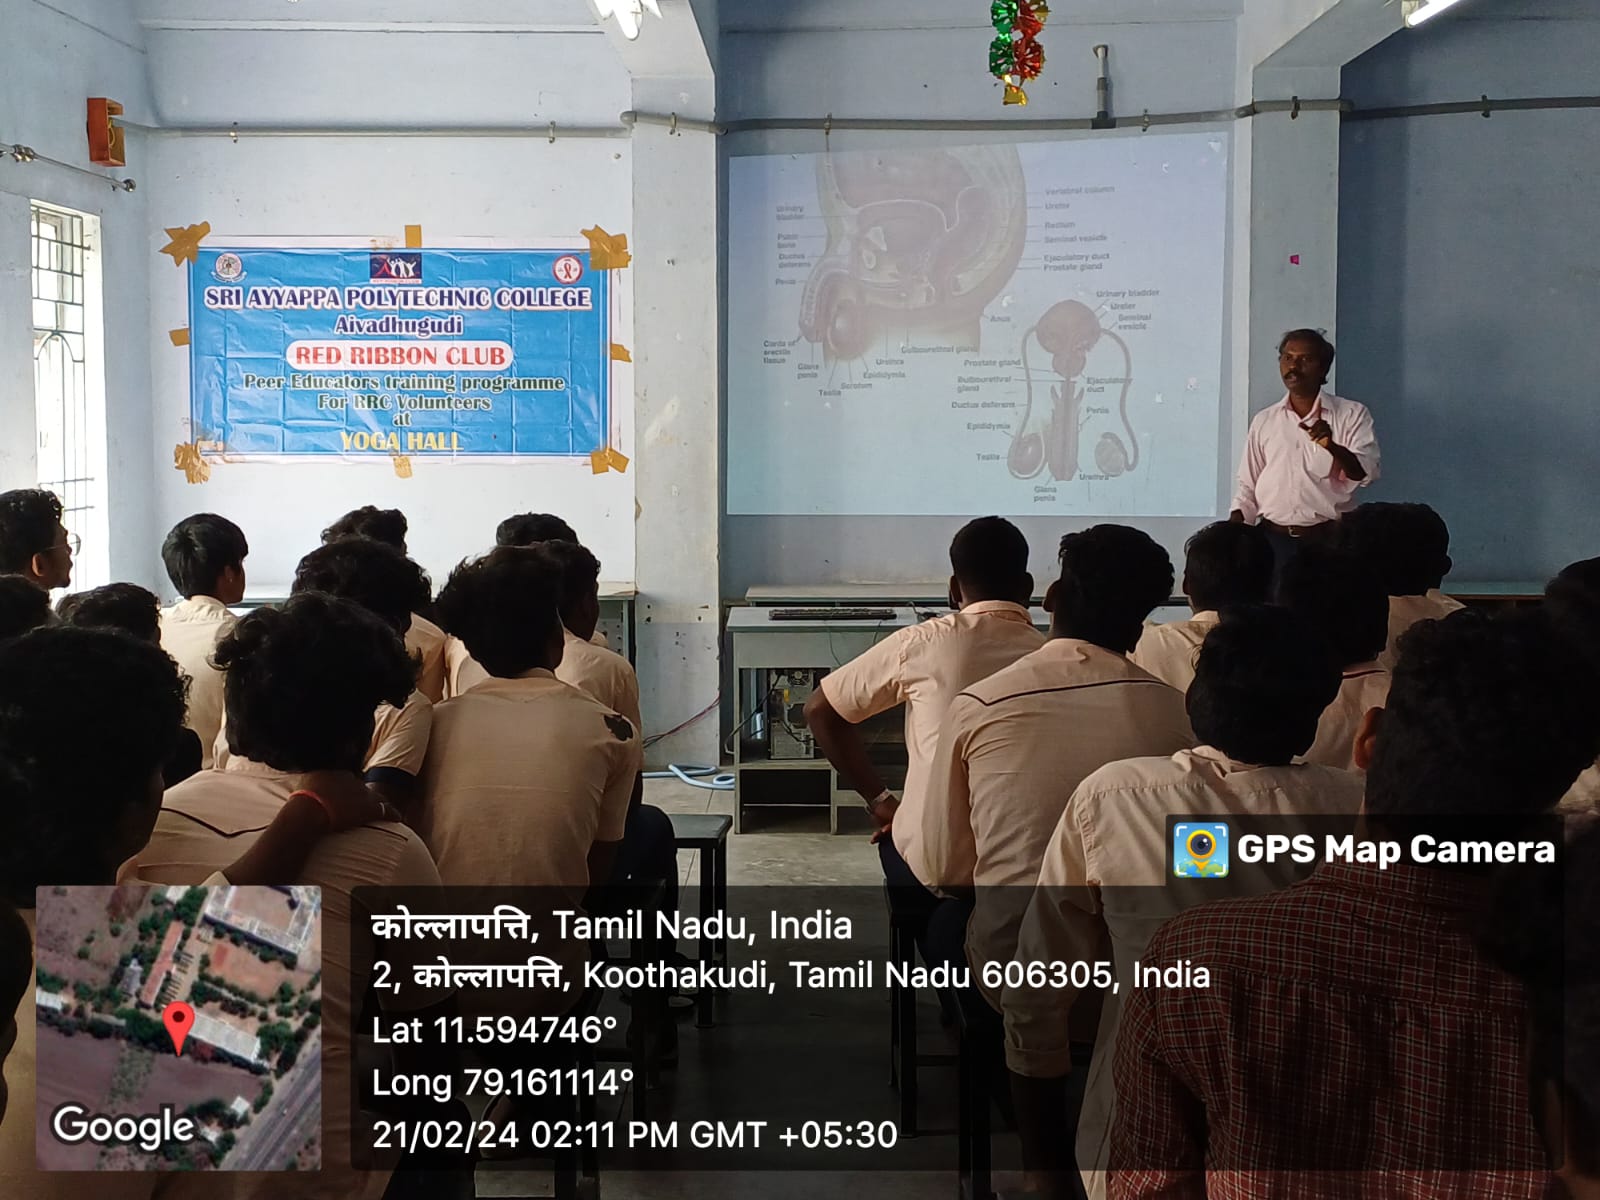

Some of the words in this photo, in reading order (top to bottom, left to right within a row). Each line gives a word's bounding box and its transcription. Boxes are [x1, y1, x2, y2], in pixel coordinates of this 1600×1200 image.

[206, 288, 241, 308] SRI
[248, 287, 340, 308] AYYAPPA
[347, 287, 489, 308] POLYTECHNIC
[496, 287, 591, 309] COLLEGE
[334, 316, 463, 338] Aivadhugudi
[296, 346, 342, 365] RED
[350, 346, 438, 365] RIBBON
[446, 346, 506, 365] CLUB
[245, 374, 284, 389] Peer
[291, 374, 379, 390] Educators
[386, 374, 455, 393] training
[461, 376, 565, 393] programme
[319, 394, 348, 409] For
[353, 394, 392, 409] RRC
[397, 394, 491, 409] Volunteers
[393, 411, 411, 426] at
[340, 431, 399, 450] YOGA
[407, 431, 464, 450] HALL
